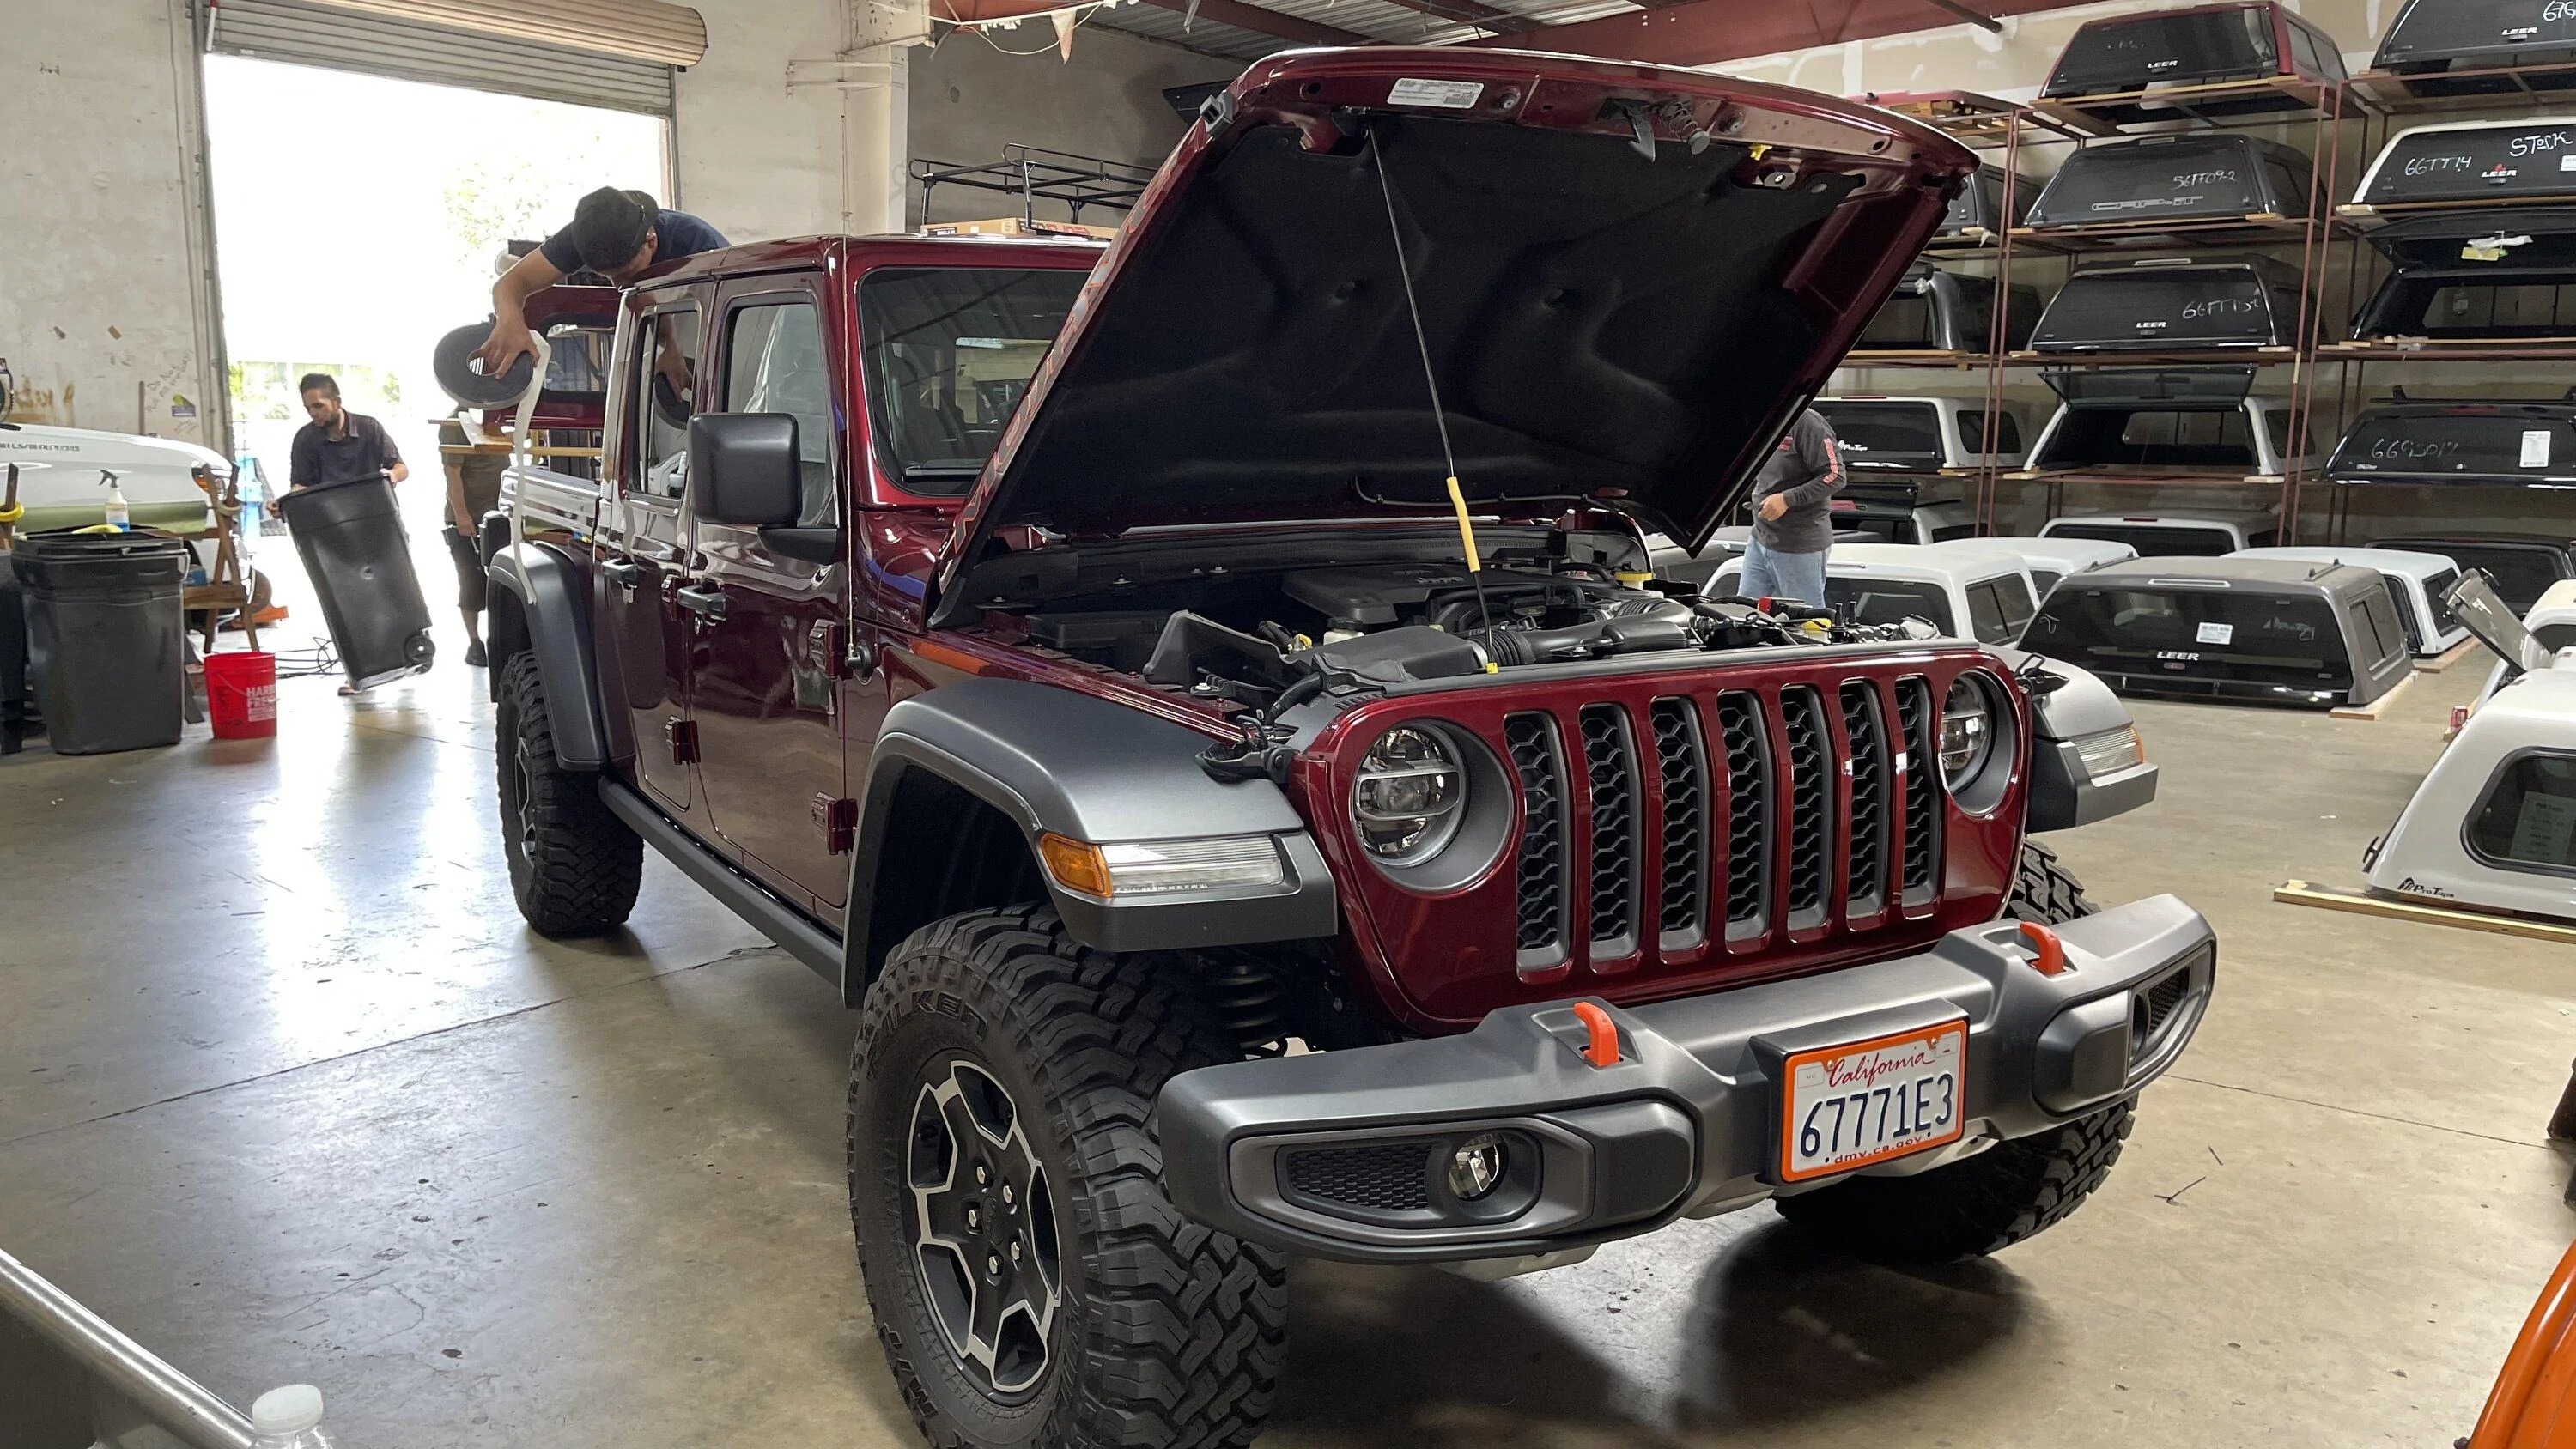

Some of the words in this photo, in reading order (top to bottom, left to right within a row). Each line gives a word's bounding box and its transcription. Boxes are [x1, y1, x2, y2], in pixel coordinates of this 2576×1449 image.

[2501, 27, 2538, 36] LEER
[2147, 60, 2178, 70] LEER
[2509, 131, 2573, 157] STOCK
[2481, 169, 2518, 179] LEER
[2156, 650, 2200, 661] LEER
[1828, 1052, 1936, 1088] California
[1800, 1072, 1953, 1158] 67771E3
